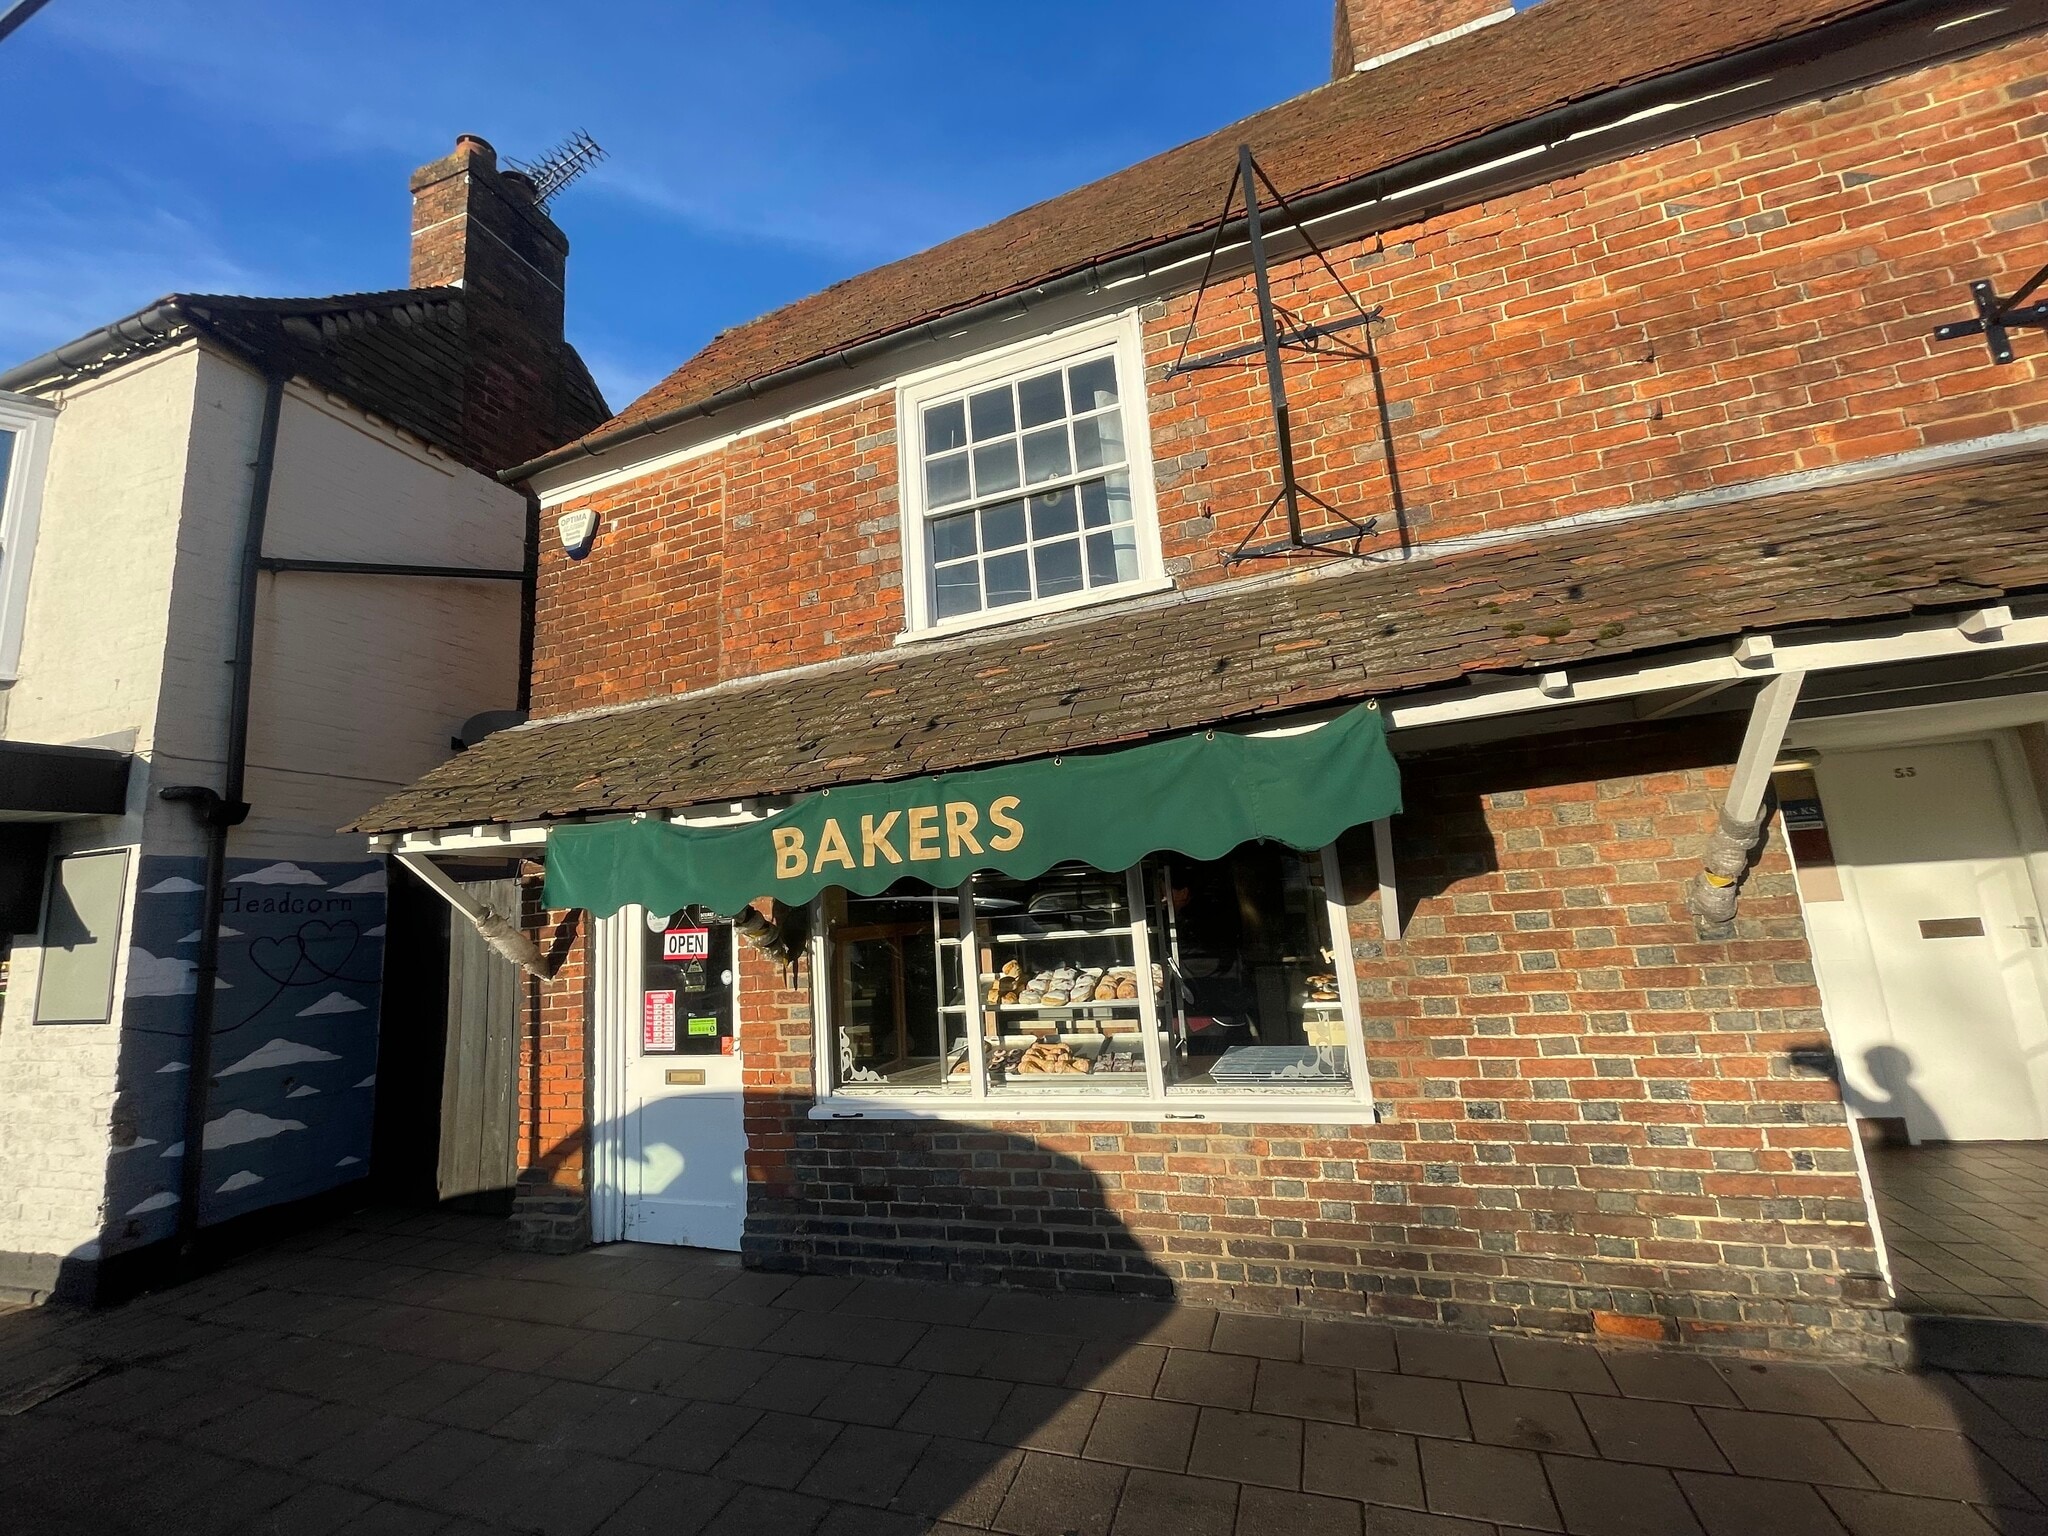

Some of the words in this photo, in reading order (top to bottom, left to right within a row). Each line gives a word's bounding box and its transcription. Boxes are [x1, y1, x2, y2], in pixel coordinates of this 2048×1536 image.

[560, 512, 587, 527] OPTIMA
[771, 794, 1025, 880] BAKERS
[220, 887, 352, 913] Headcorn
[669, 934, 704, 953] OPEN
